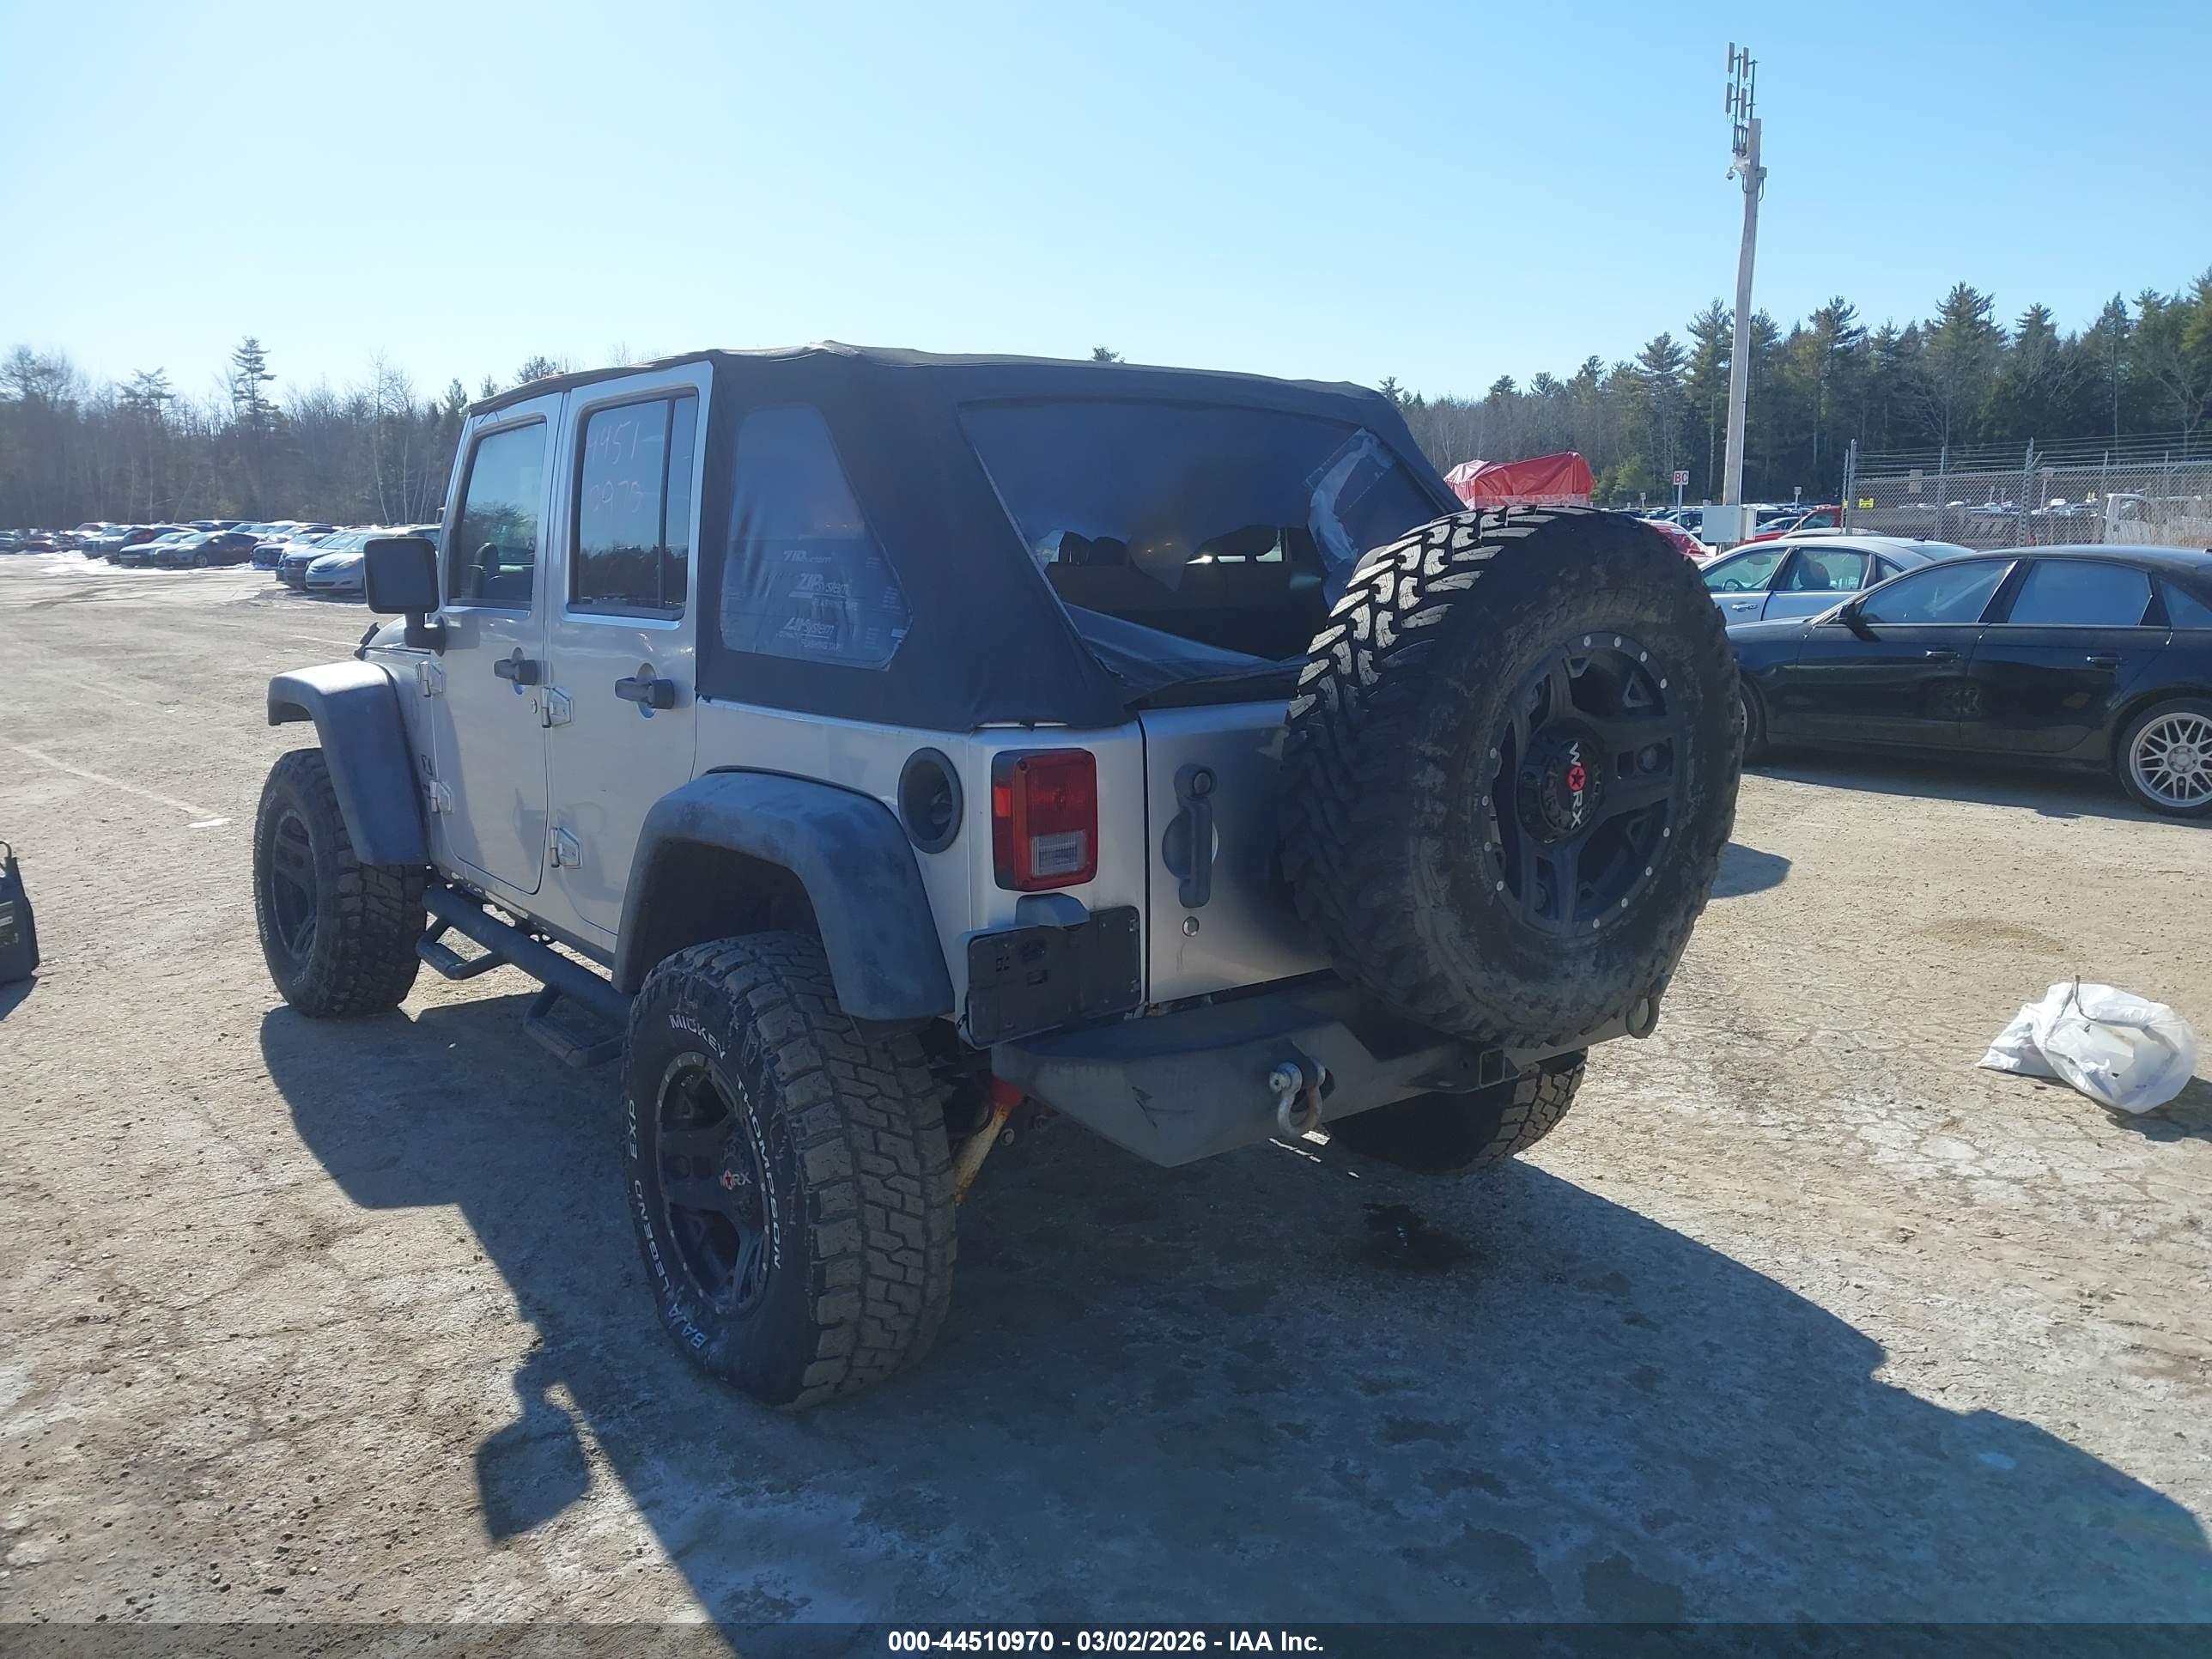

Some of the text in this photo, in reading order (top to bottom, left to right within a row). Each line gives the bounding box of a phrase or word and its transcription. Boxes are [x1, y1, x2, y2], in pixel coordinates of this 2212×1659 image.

[587, 420, 639, 465] 4451
[1674, 472, 1688, 483] BC
[1567, 742, 1587, 829] WORX
[668, 1014, 782, 1270] MICKEY THOMPSON
[627, 1098, 709, 1351] BAJA LEGEND EXP
